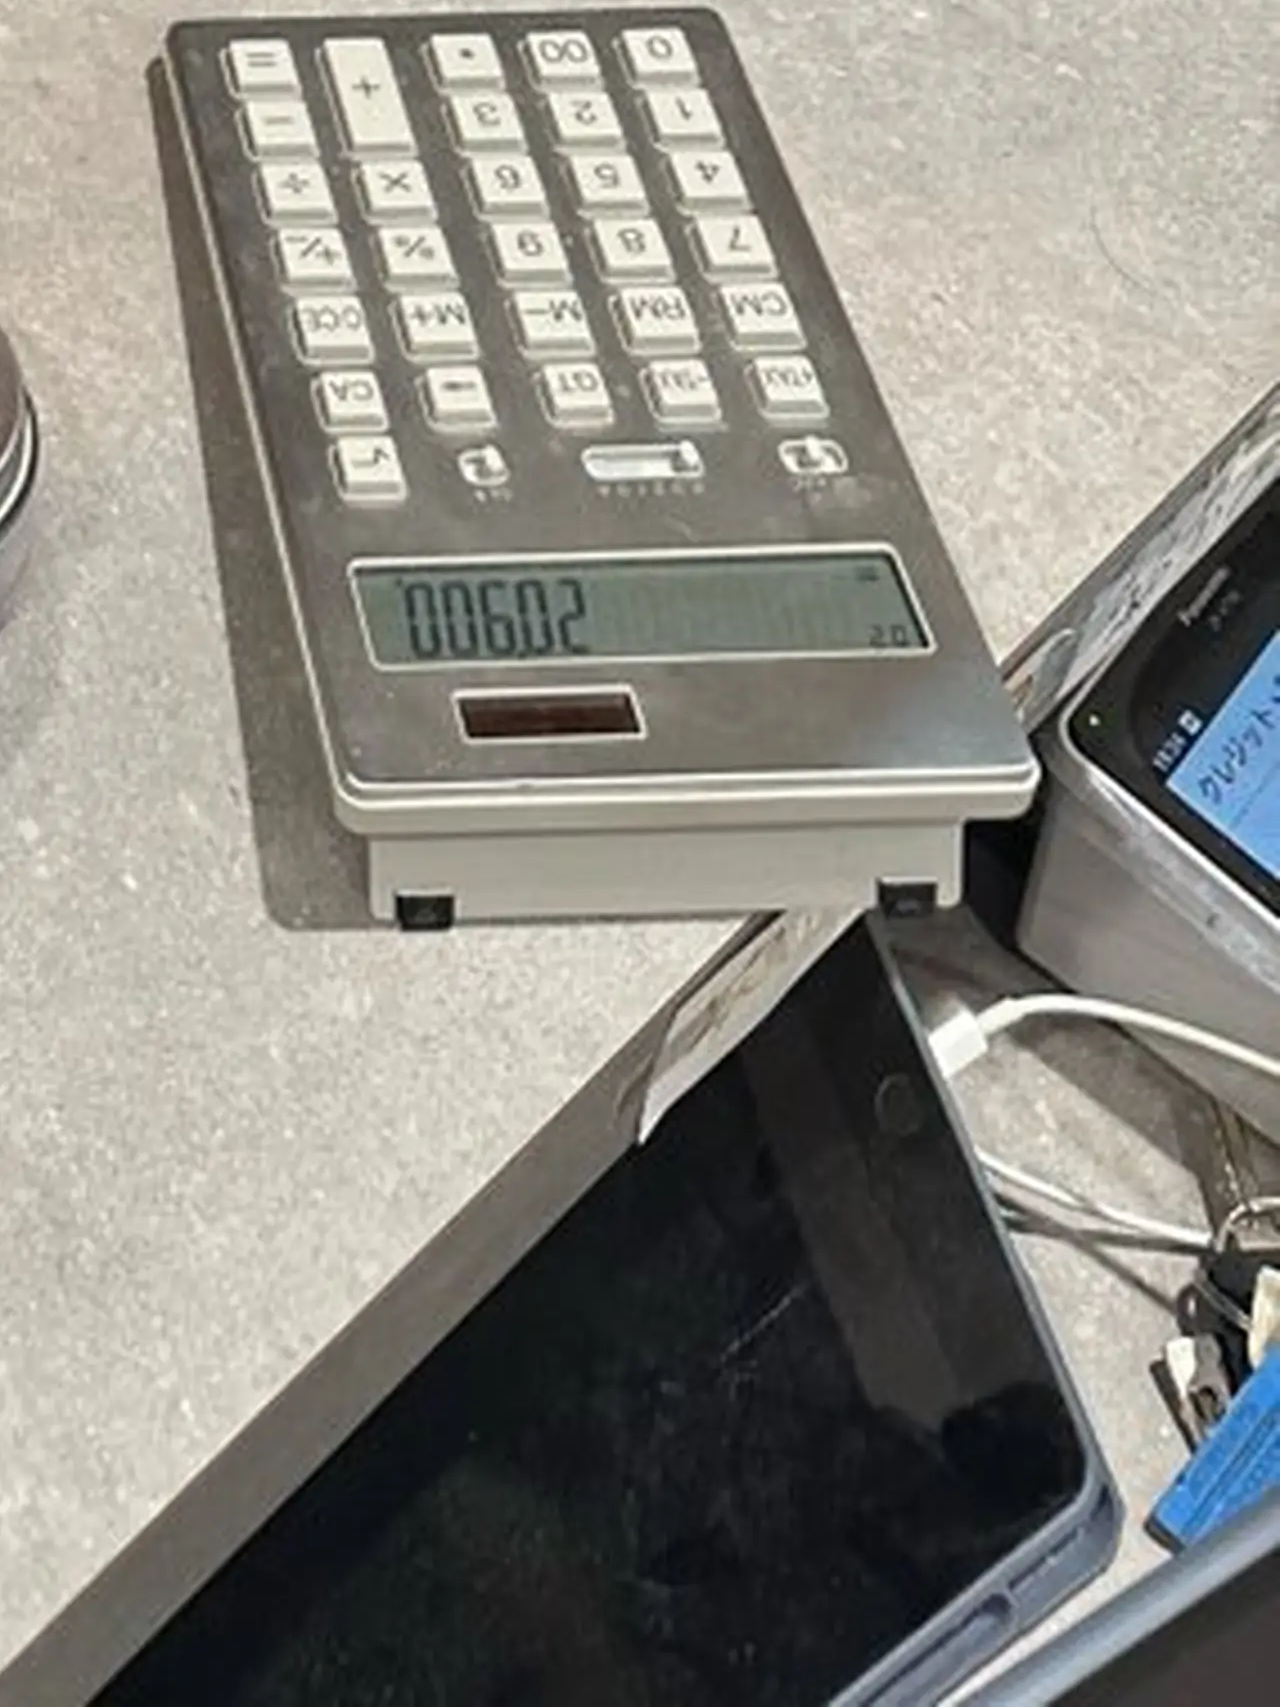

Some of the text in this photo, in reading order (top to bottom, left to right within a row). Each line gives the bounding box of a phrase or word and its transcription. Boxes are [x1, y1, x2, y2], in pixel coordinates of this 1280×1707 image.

[539, 39, 588, 64] 00
[645, 35, 673, 60] 0
[472, 102, 501, 127] 3
[571, 99, 598, 125] 2
[675, 97, 693, 121] 1
[494, 164, 521, 191] 6
[593, 163, 620, 189] 5
[695, 161, 721, 185] 4
[517, 230, 544, 257] 9
[617, 227, 646, 253] 8
[727, 226, 752, 252] 7
[630, 295, 686, 321] RM
[730, 291, 788, 317] CM
[327, 379, 374, 402] CA
